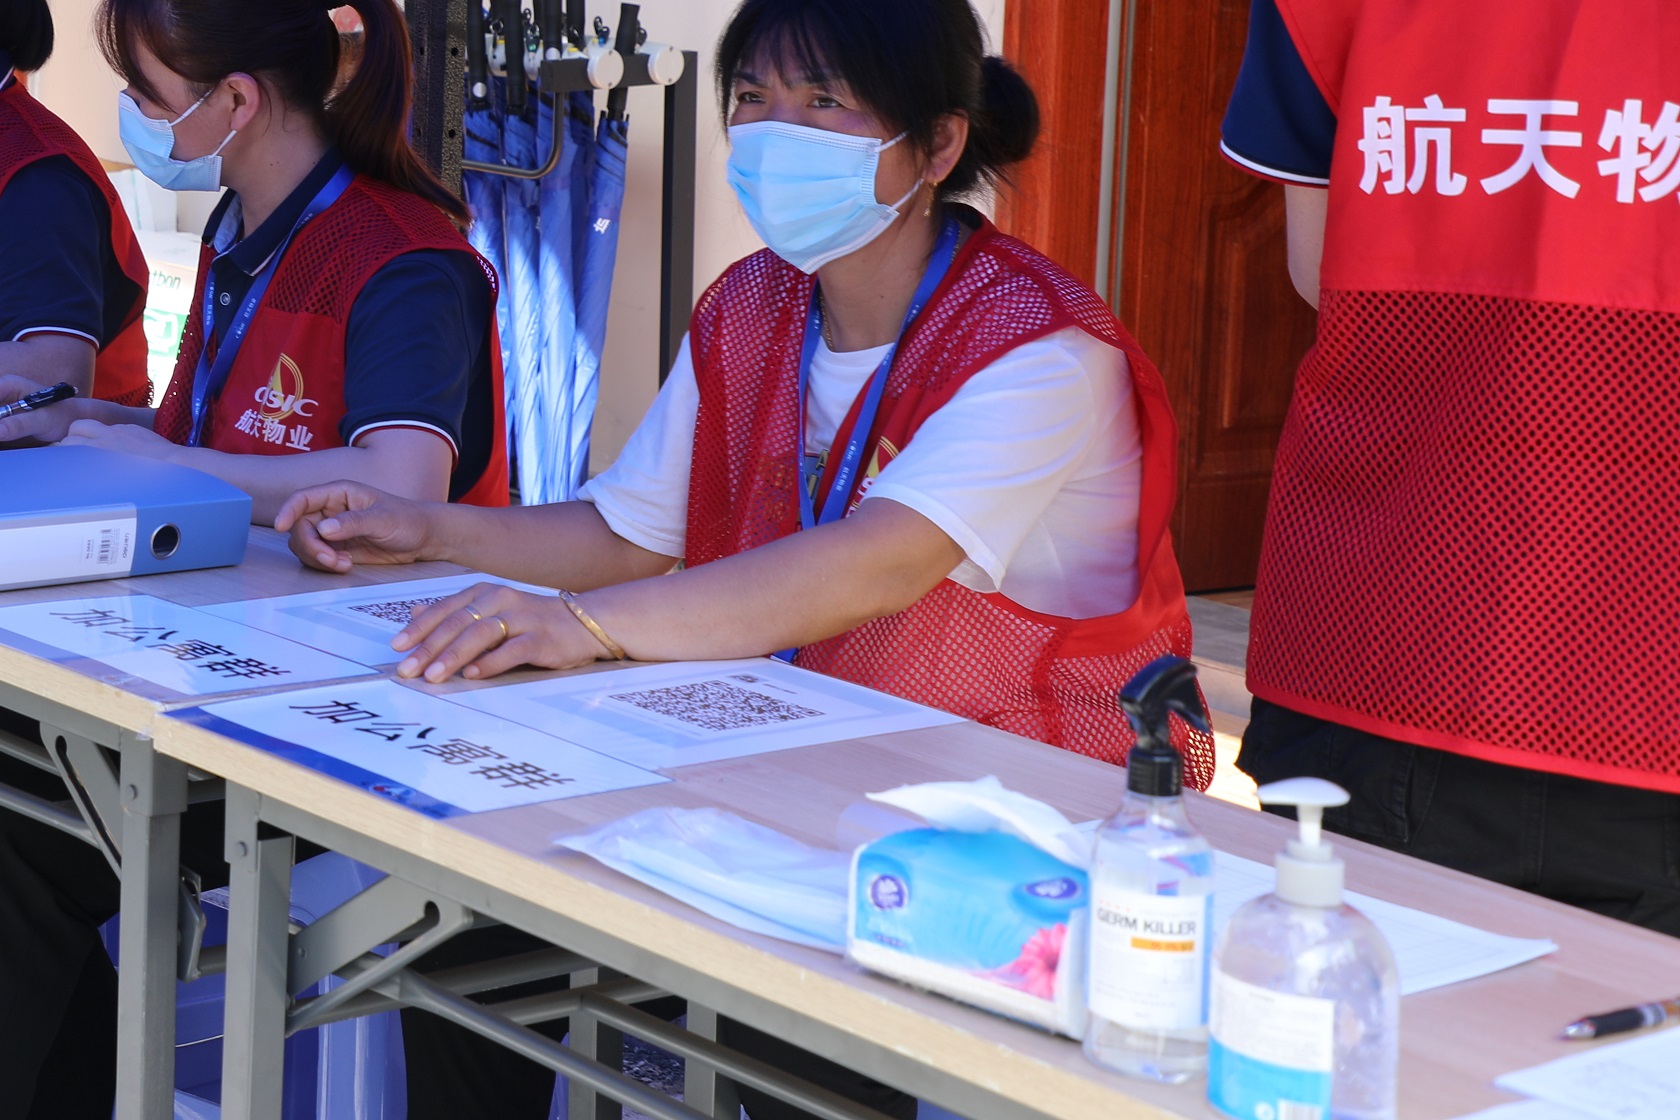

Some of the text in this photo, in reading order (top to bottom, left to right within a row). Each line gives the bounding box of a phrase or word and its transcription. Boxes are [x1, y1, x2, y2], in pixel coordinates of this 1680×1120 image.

[49, 608, 292, 679] 加公寓群
[288, 700, 576, 790] 加公寓群
[1097, 906, 1197, 935] GERM KILLER
